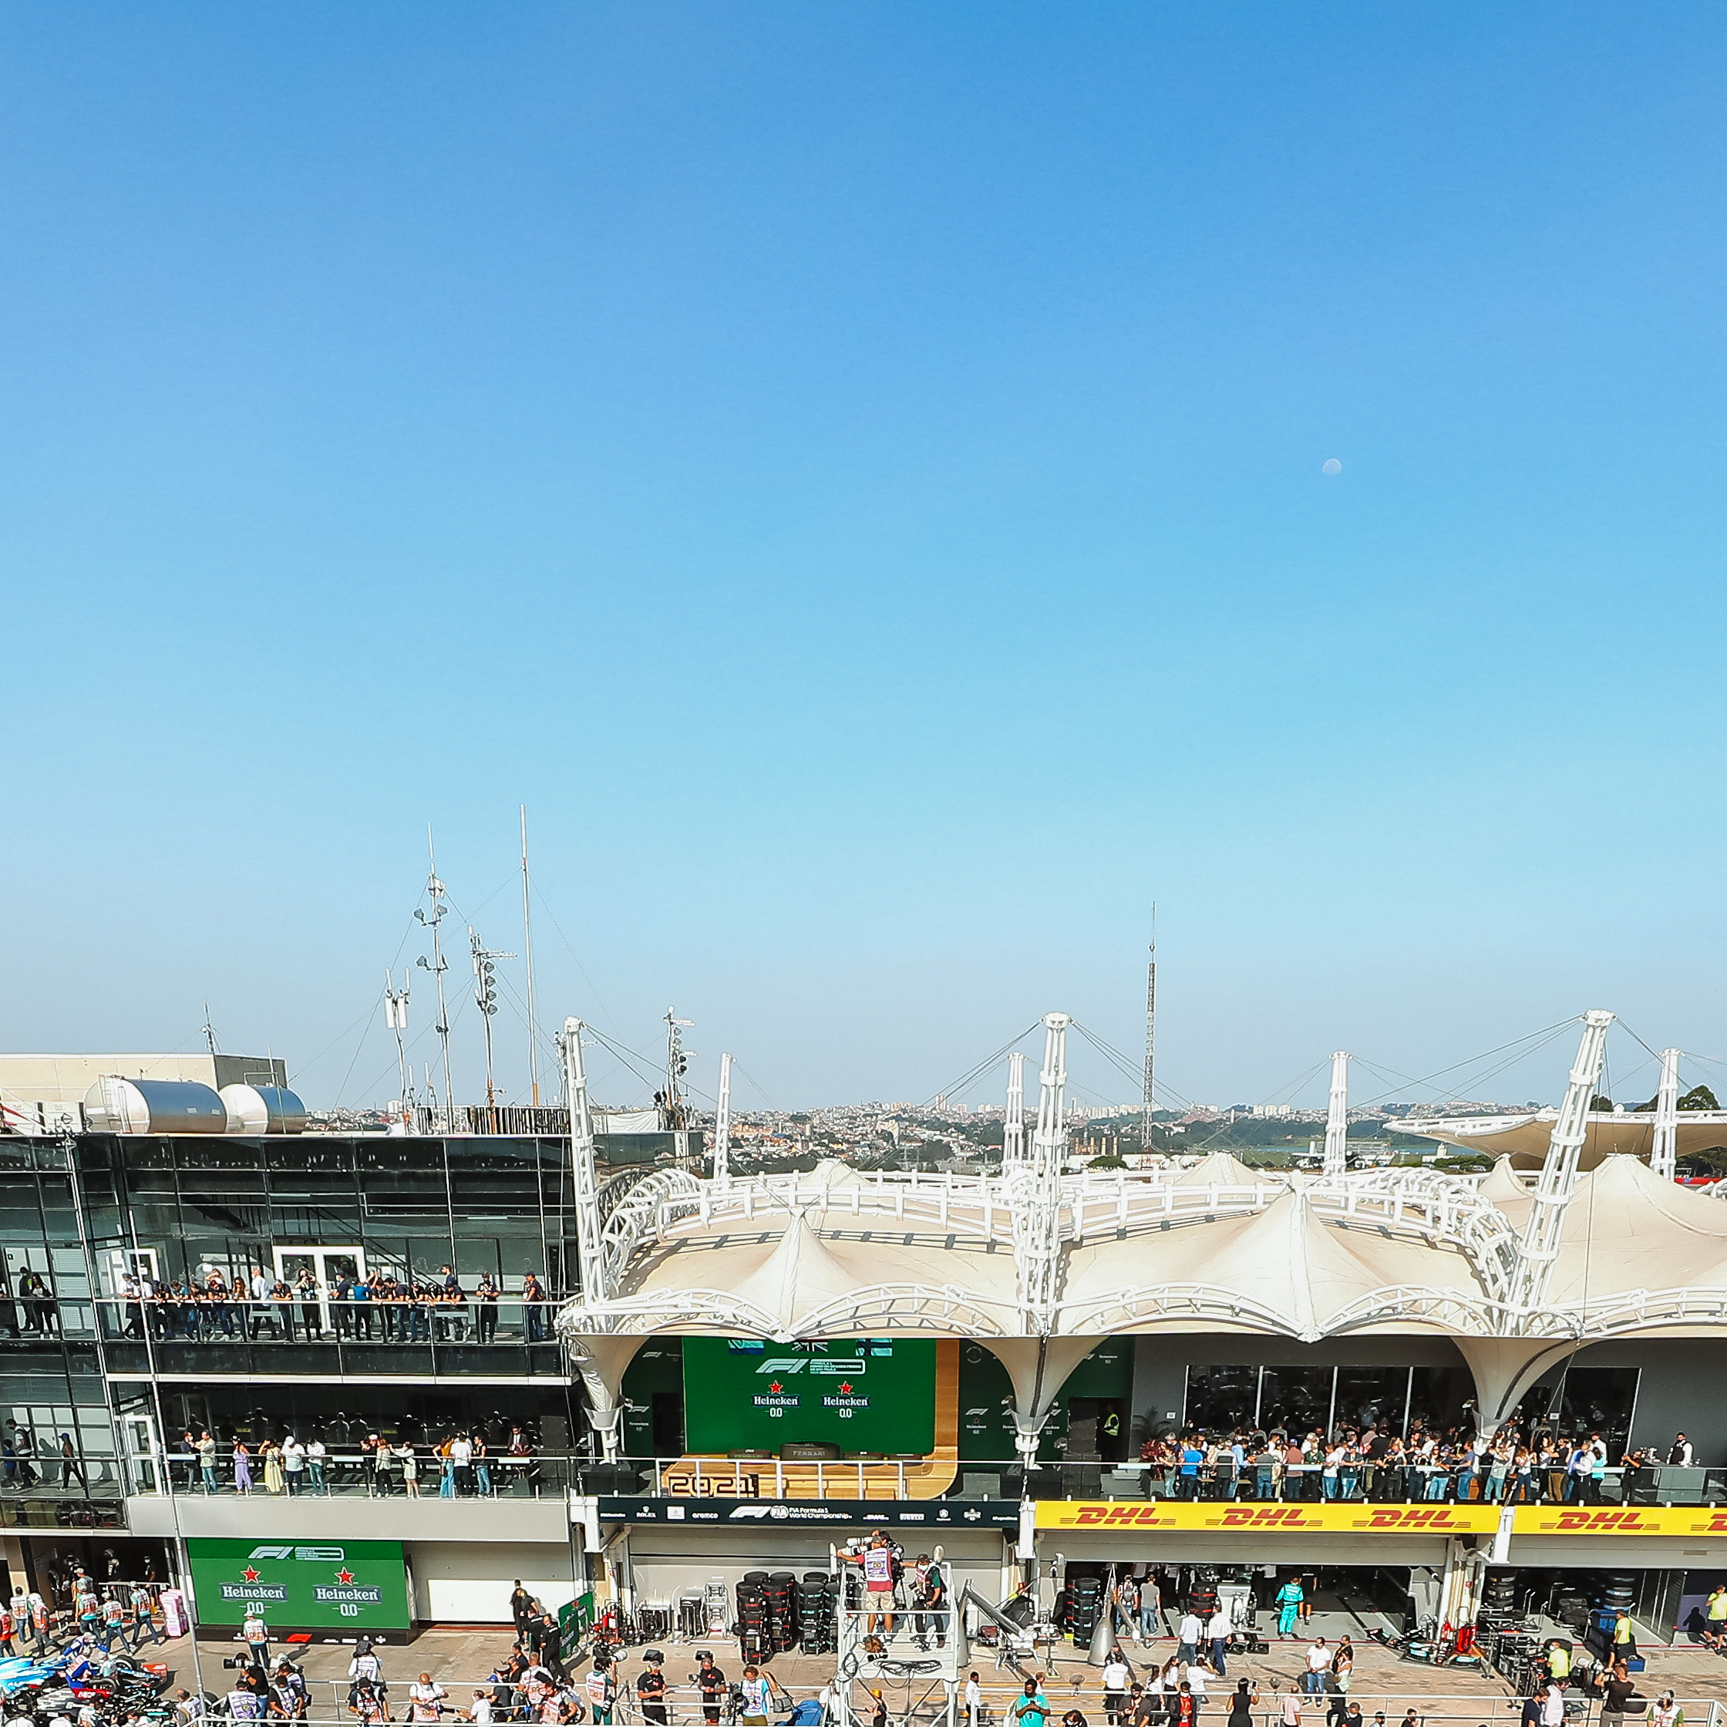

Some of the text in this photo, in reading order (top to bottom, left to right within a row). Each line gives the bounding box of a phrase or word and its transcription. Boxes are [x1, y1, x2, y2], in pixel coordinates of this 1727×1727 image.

[754, 1396, 799, 1406] Heineken
[823, 1397, 869, 1406] Heineken
[1079, 1508, 1157, 1525] DHL
[1224, 1509, 1303, 1526] DHL
[1371, 1511, 1452, 1528] DHL
[1559, 1513, 1641, 1530] DHL
[223, 1586, 284, 1599] Heineken
[316, 1588, 378, 1601] Heineken
